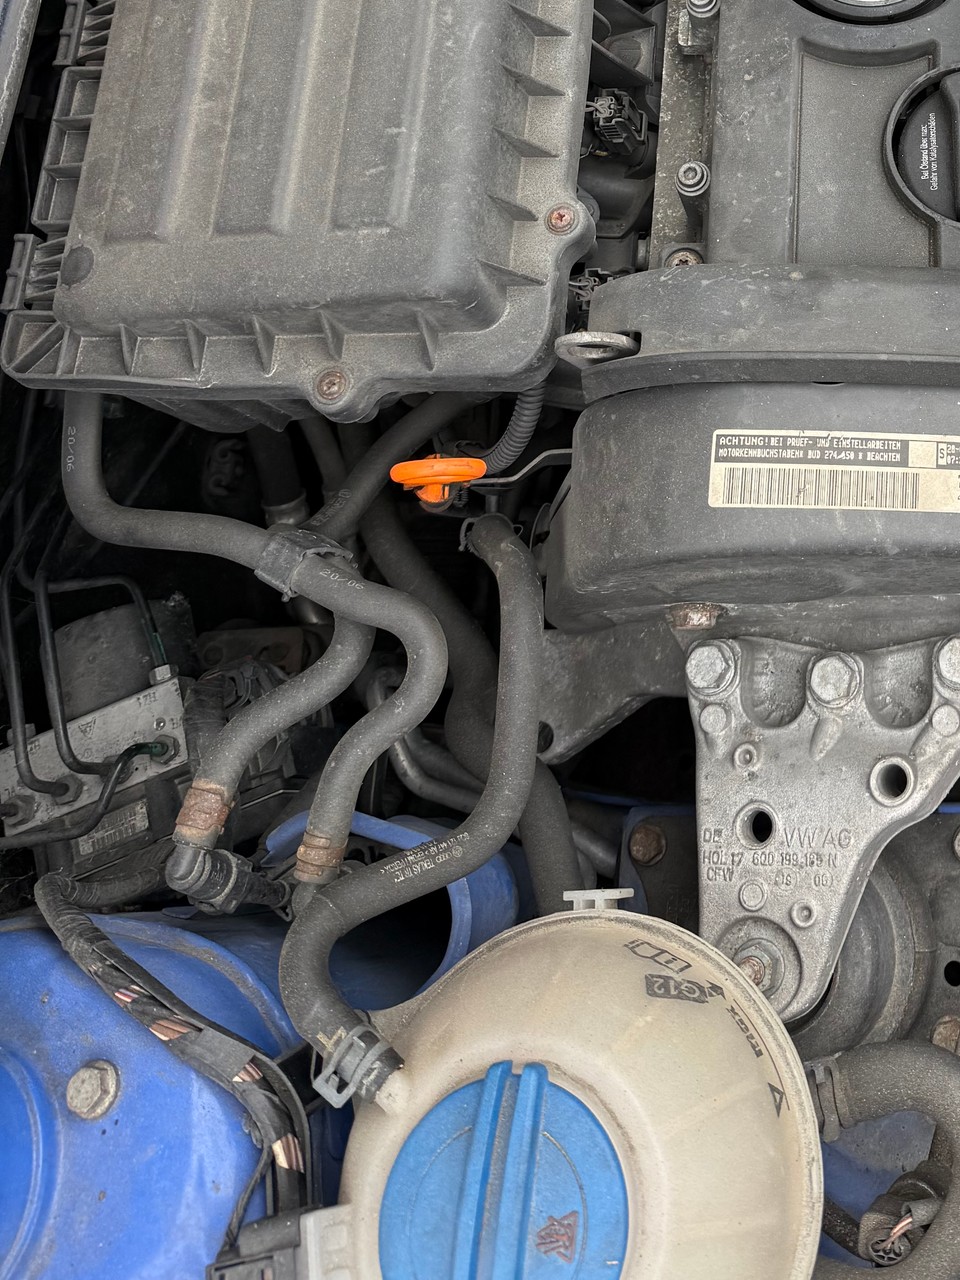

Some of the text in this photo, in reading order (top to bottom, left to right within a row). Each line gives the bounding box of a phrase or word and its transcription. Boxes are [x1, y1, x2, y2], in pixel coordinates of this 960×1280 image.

[929, 172, 937, 190] Gefahr
[719, 434, 768, 446] ACHTUNG!
[770, 436, 782, 446] BEI
[786, 436, 812, 447] PRUEF-
[67, 426, 76, 472] 20/06
[866, 451, 900, 461] BEACHTEN
[939, 448, 944, 458] S
[784, 827, 851, 848] VW AG
[412, 858, 434, 874] TEKLAS
[828, 853, 837, 868] N
[653, 978, 700, 998] G12
